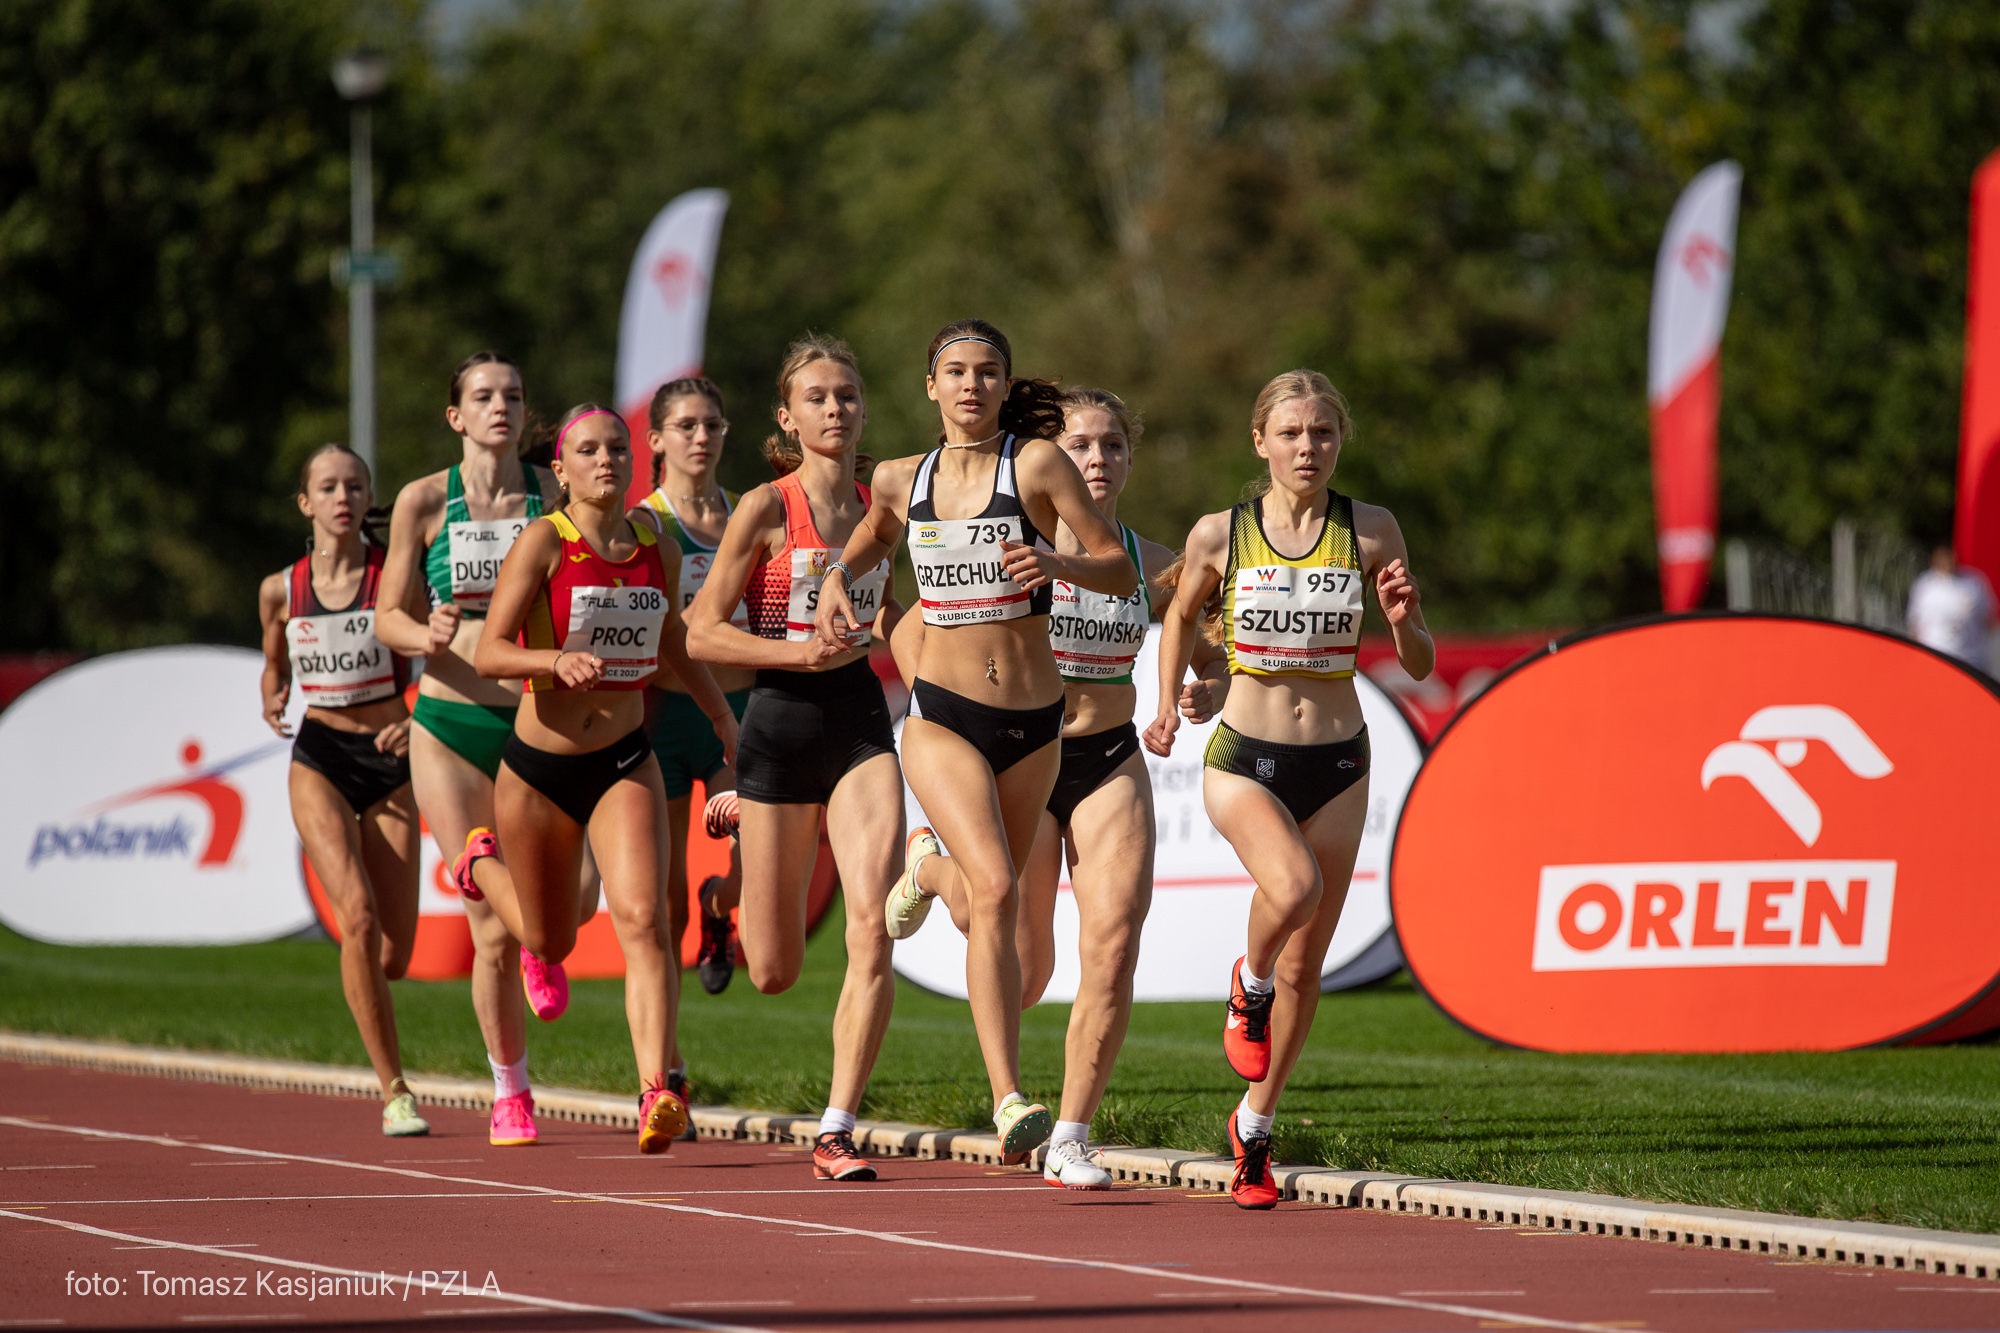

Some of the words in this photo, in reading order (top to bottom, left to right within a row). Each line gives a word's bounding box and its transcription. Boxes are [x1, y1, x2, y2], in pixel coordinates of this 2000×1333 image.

[466, 531, 499, 542] FUEL
[967, 523, 1011, 546] 739
[456, 559, 503, 581] DUSI
[918, 561, 1013, 588] GRZECHUŁ
[1307, 573, 1351, 594] 957
[588, 597, 619, 608] FUEL
[629, 592, 660, 610] 308
[806, 588, 875, 611] SHA
[1053, 595, 1081, 604] ORLEN
[937, 612, 977, 621] SŁUBICE
[978, 608, 1004, 619] 2023
[1241, 609, 1353, 634] SZUSTER
[344, 617, 369, 635] 49
[590, 627, 648, 647] PROC
[298, 648, 380, 673] DŻUGAJ
[1058, 662, 1096, 674] SŁUBICE
[1261, 658, 1304, 668] SŁUBICE
[1306, 660, 1330, 668] 2023
[27, 813, 193, 870] polanik
[1558, 879, 1868, 952] ORLEN
